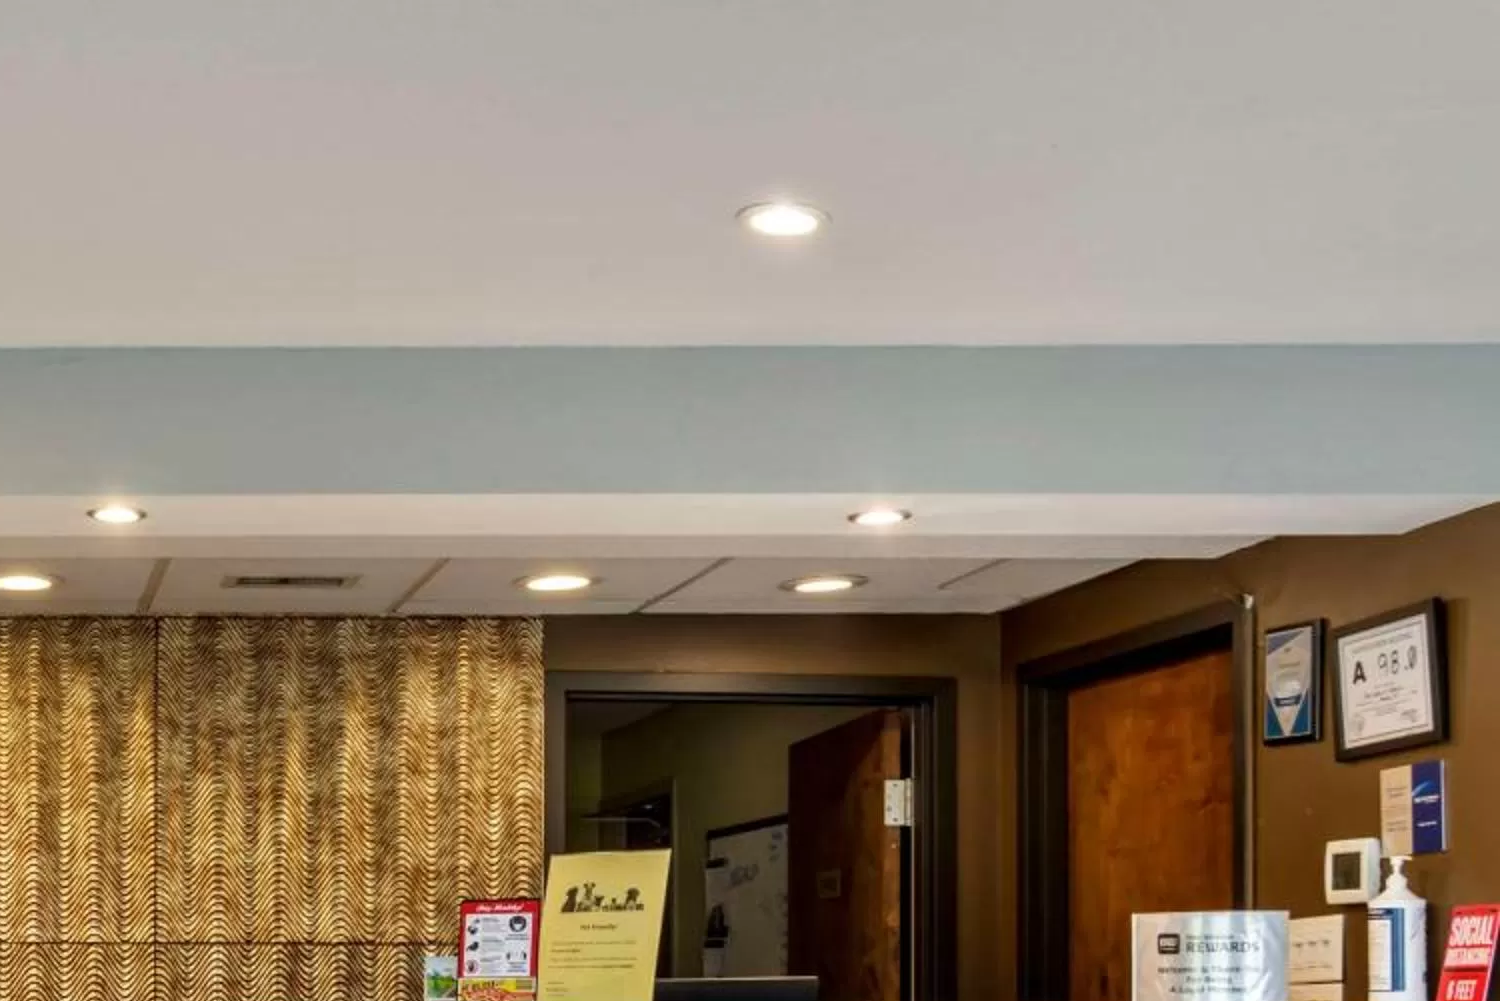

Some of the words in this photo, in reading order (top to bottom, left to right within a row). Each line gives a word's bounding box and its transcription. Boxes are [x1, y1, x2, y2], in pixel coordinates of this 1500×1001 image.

[1353, 660, 1367, 685] A
[1448, 914, 1495, 947] SOCIAL
[1184, 941, 1261, 953] REWARDS
[1453, 979, 1478, 1001] FEET
